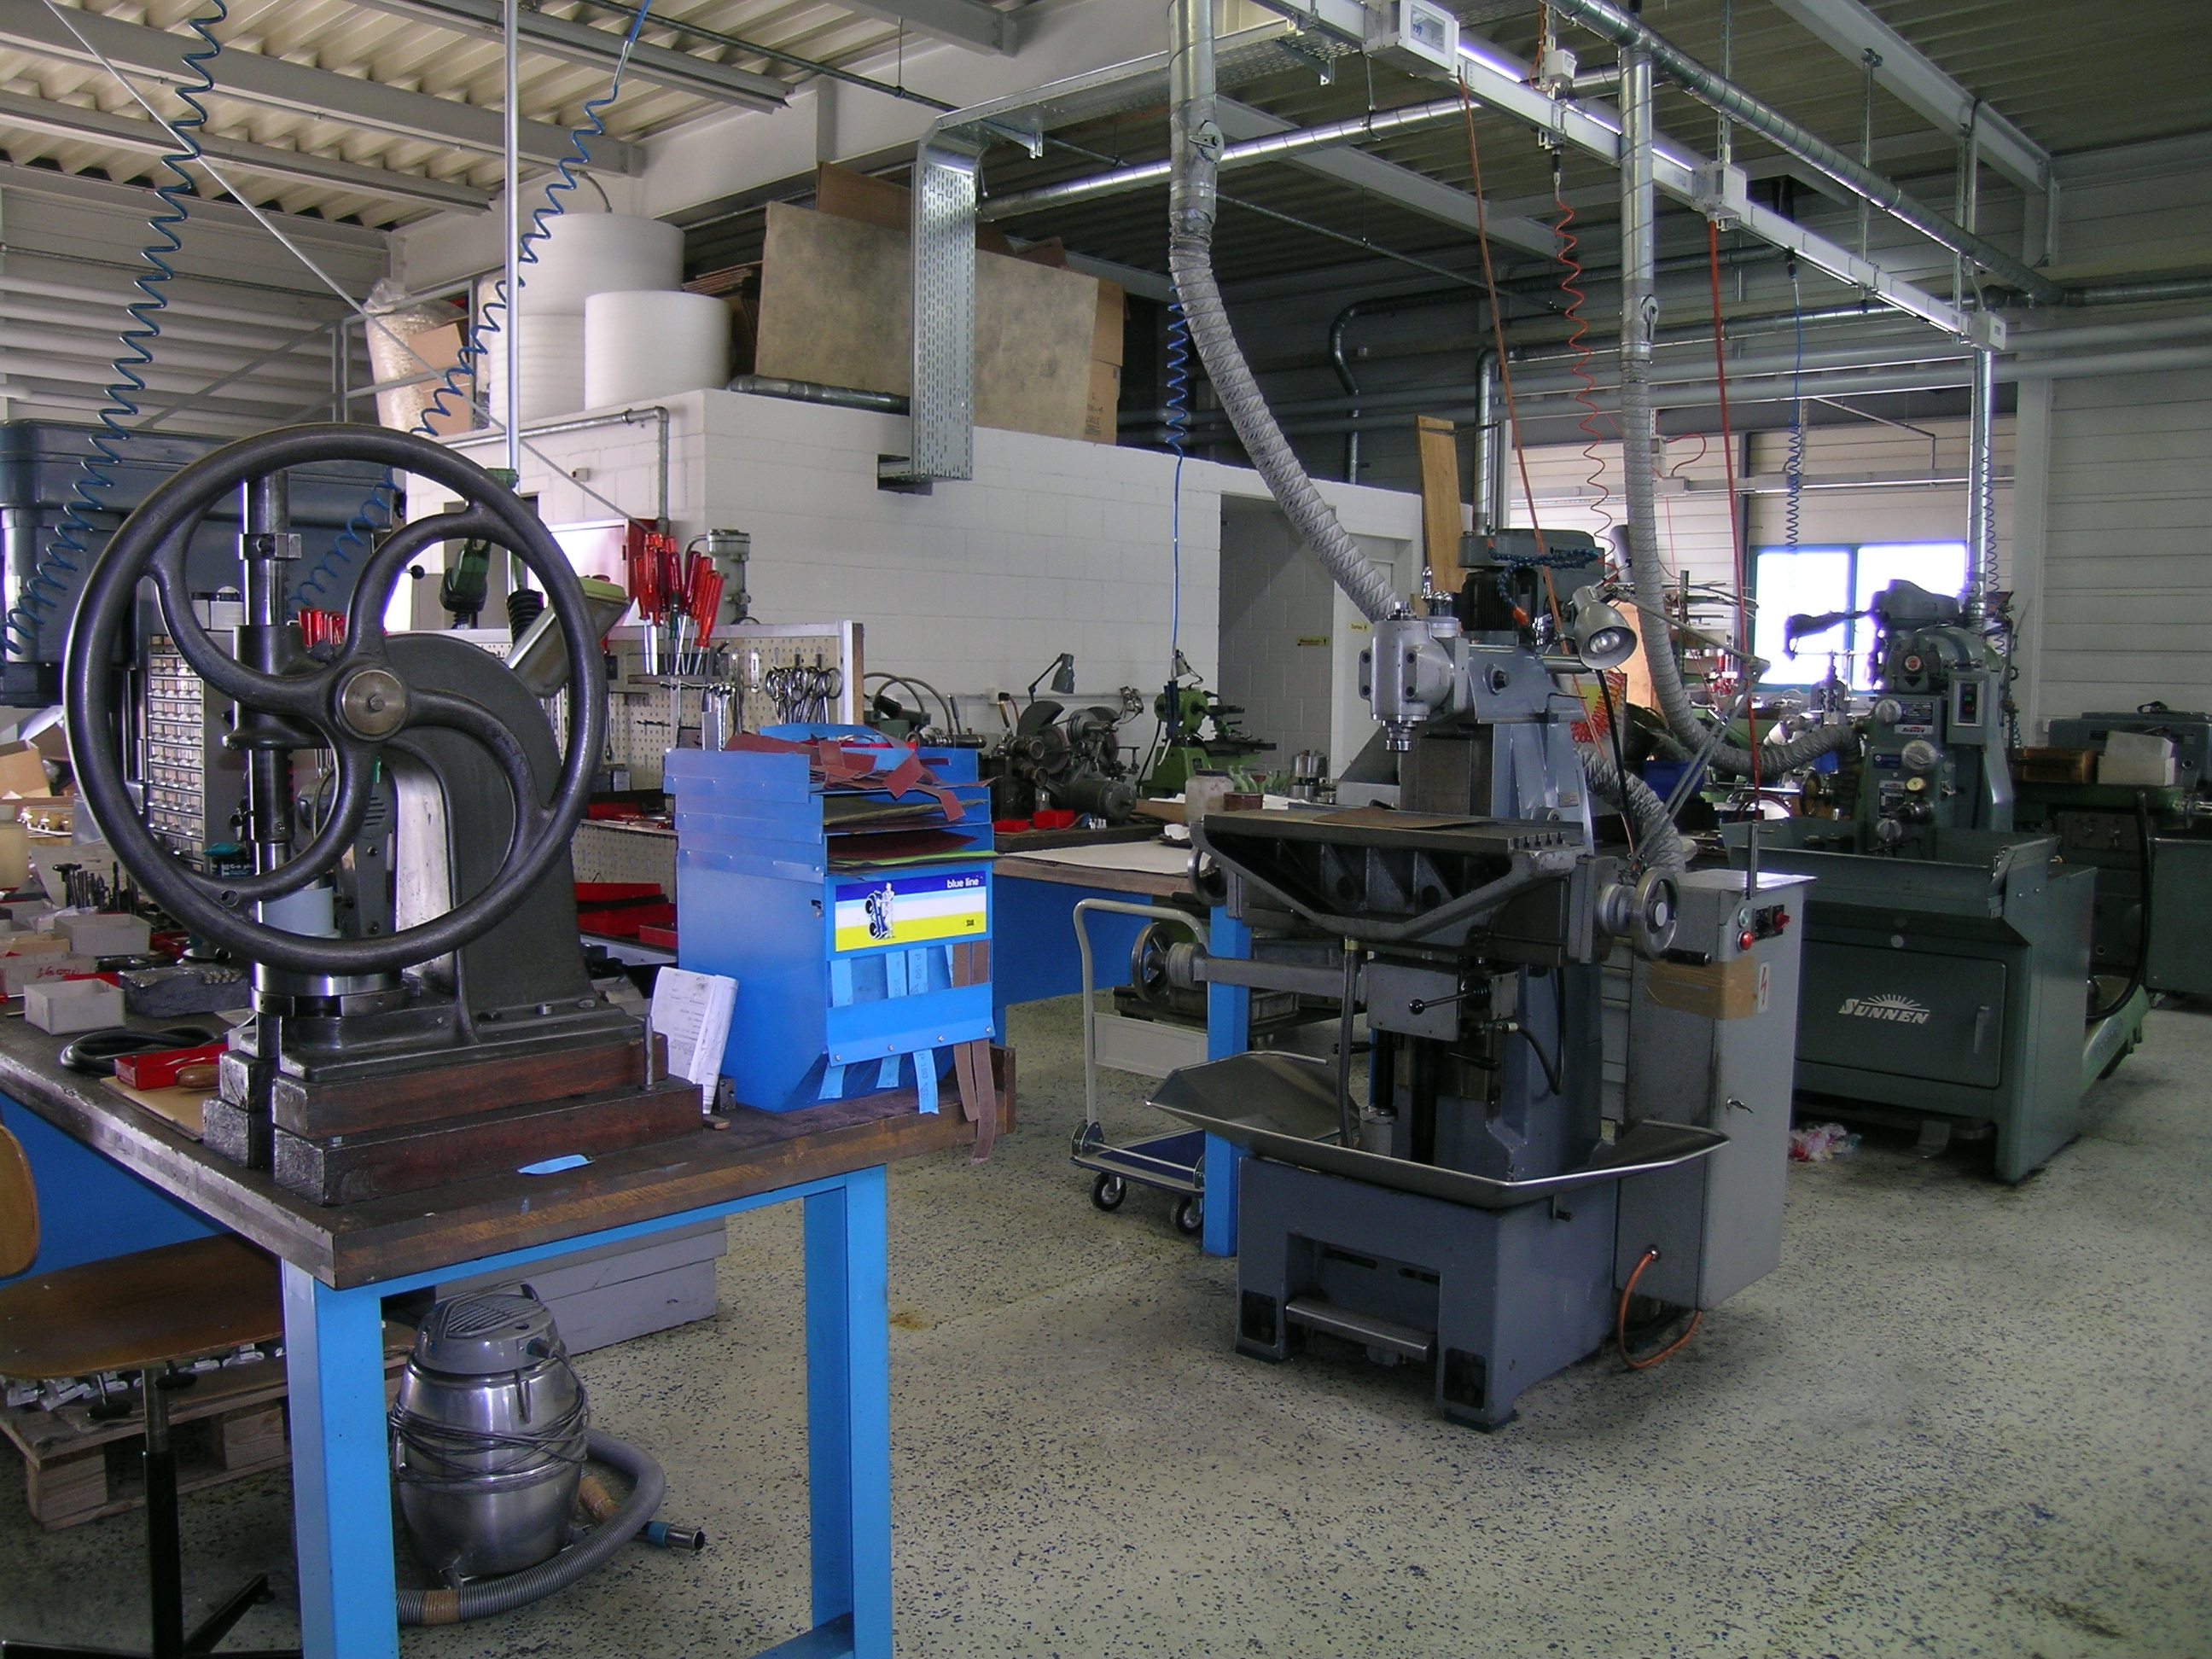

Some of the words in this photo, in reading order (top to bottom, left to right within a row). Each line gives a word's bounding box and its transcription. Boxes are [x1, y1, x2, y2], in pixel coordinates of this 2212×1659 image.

[946, 879, 963, 888] blue
[965, 877, 980, 887] line
[1838, 998, 1930, 1024] SUNNEN
